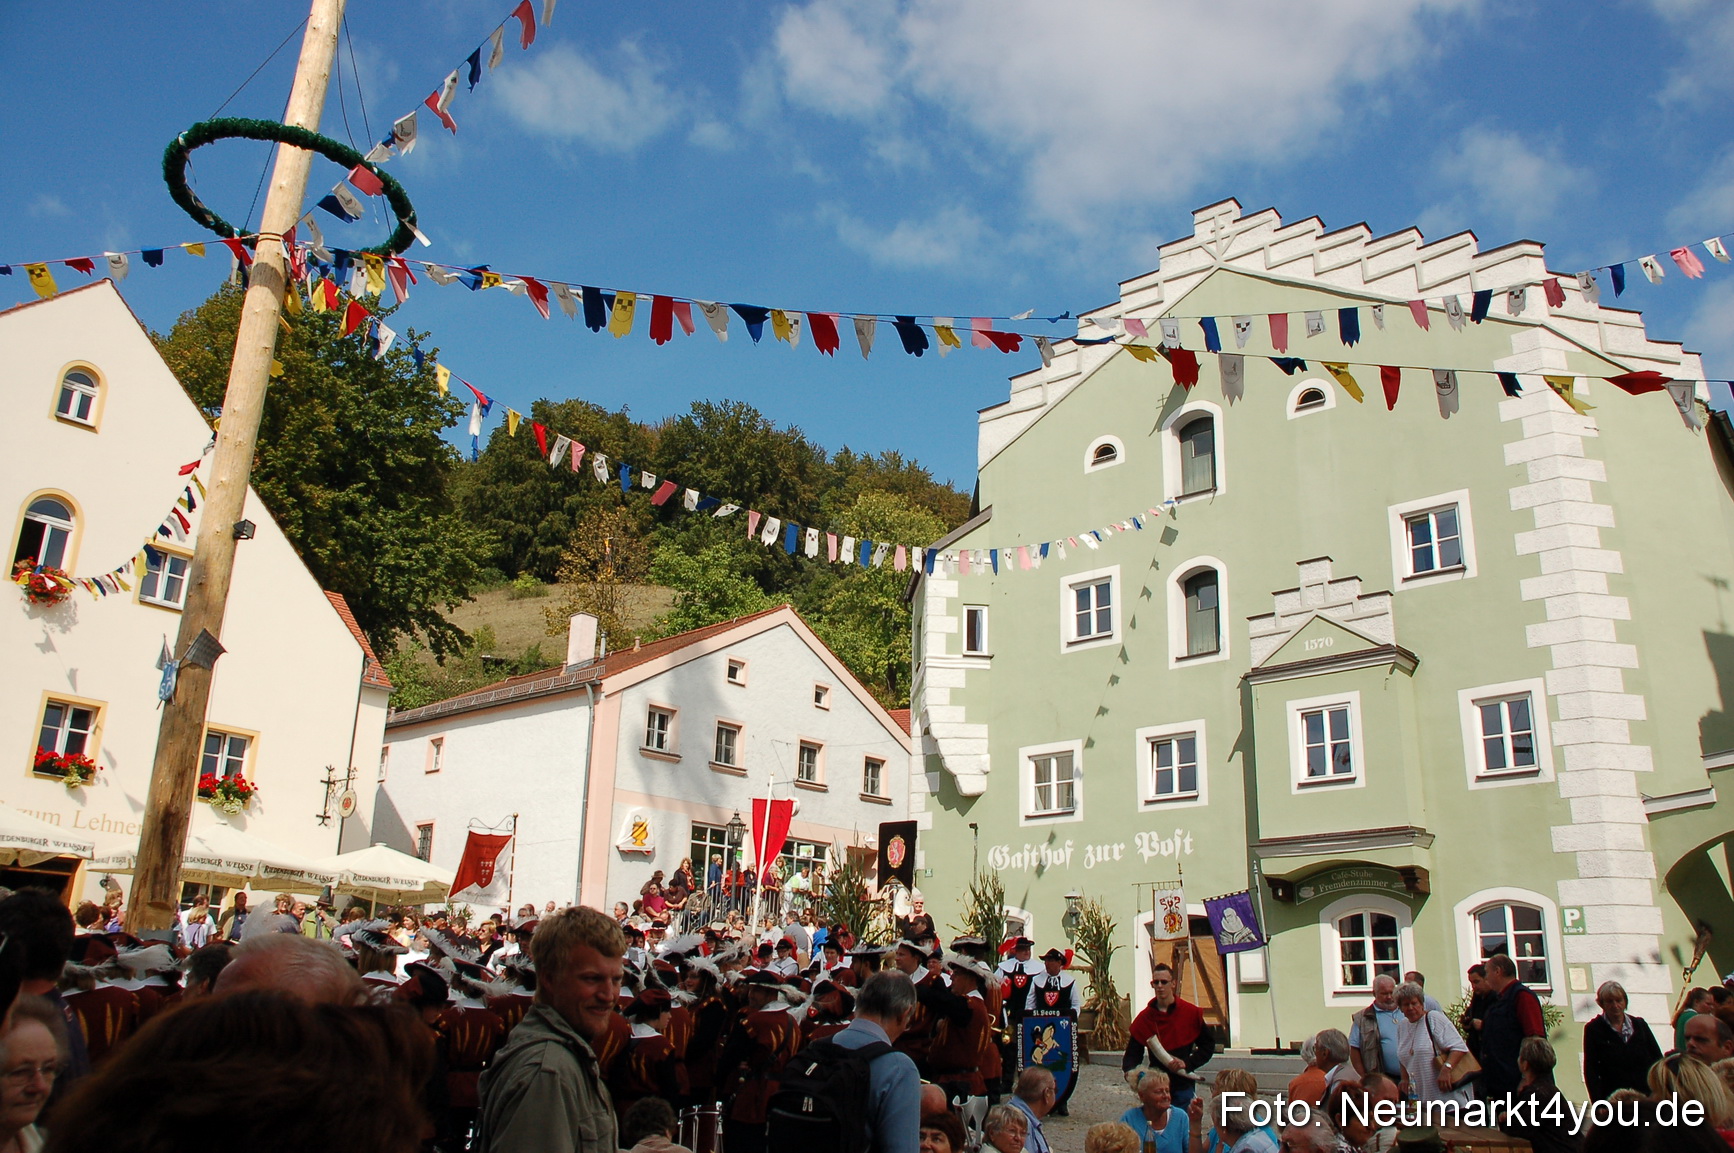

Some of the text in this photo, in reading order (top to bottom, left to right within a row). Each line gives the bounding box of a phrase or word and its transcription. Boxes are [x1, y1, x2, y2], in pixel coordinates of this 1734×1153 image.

[1304, 637, 1334, 651] 1570
[987, 828, 1194, 873] Gasthof zur Post
[263, 864, 335, 884] RIEDENBURGER WEISSE
[352, 872, 419, 888] RIEDENBURGER WEISSE
[1318, 878, 1389, 893] Fremdenzimmer
[1563, 908, 1581, 927] P
